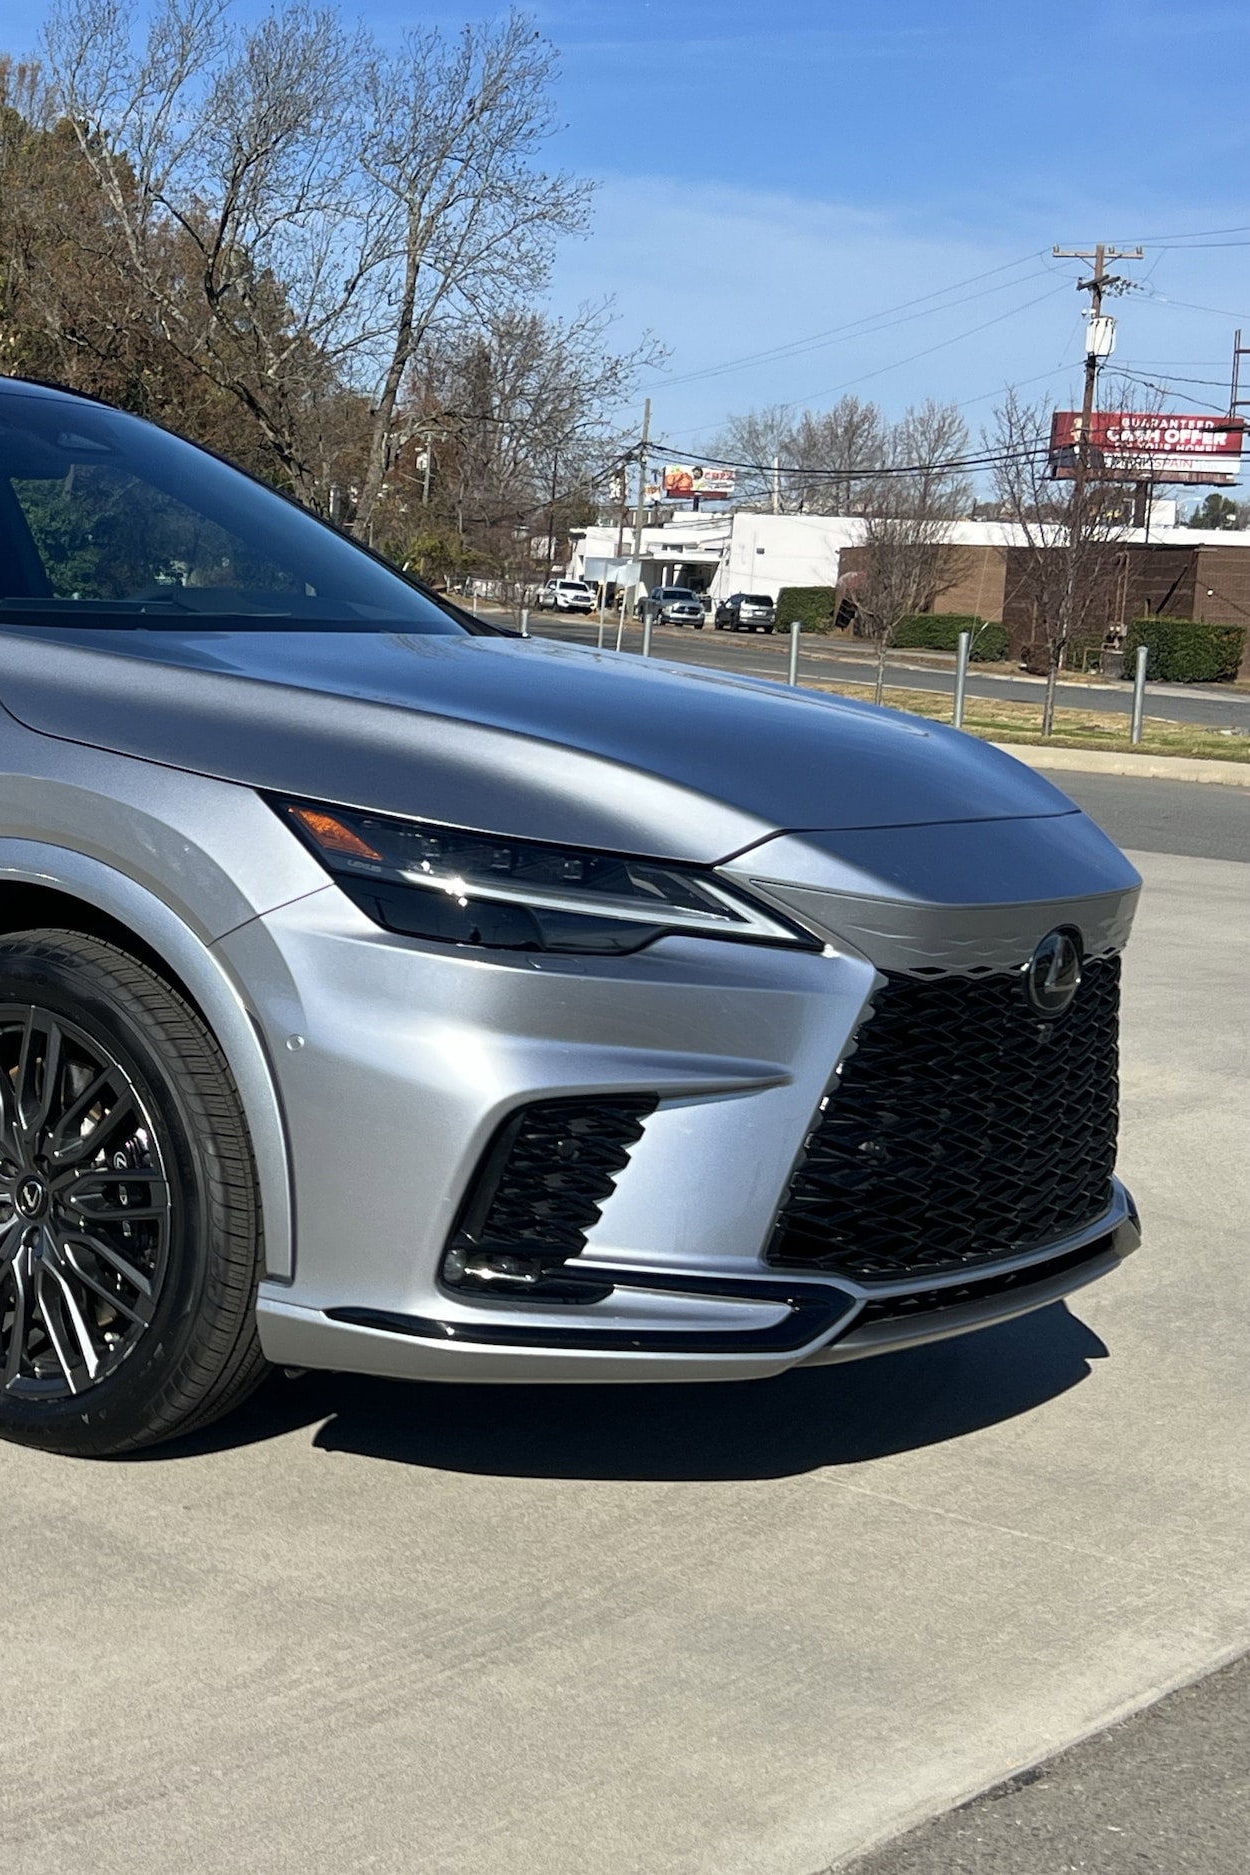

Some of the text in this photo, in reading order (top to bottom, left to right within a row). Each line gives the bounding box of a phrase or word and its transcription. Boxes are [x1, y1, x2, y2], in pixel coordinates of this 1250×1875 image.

[1121, 417, 1215, 429] GUARANTEED
[1106, 427, 1228, 446] CASH OFFER
